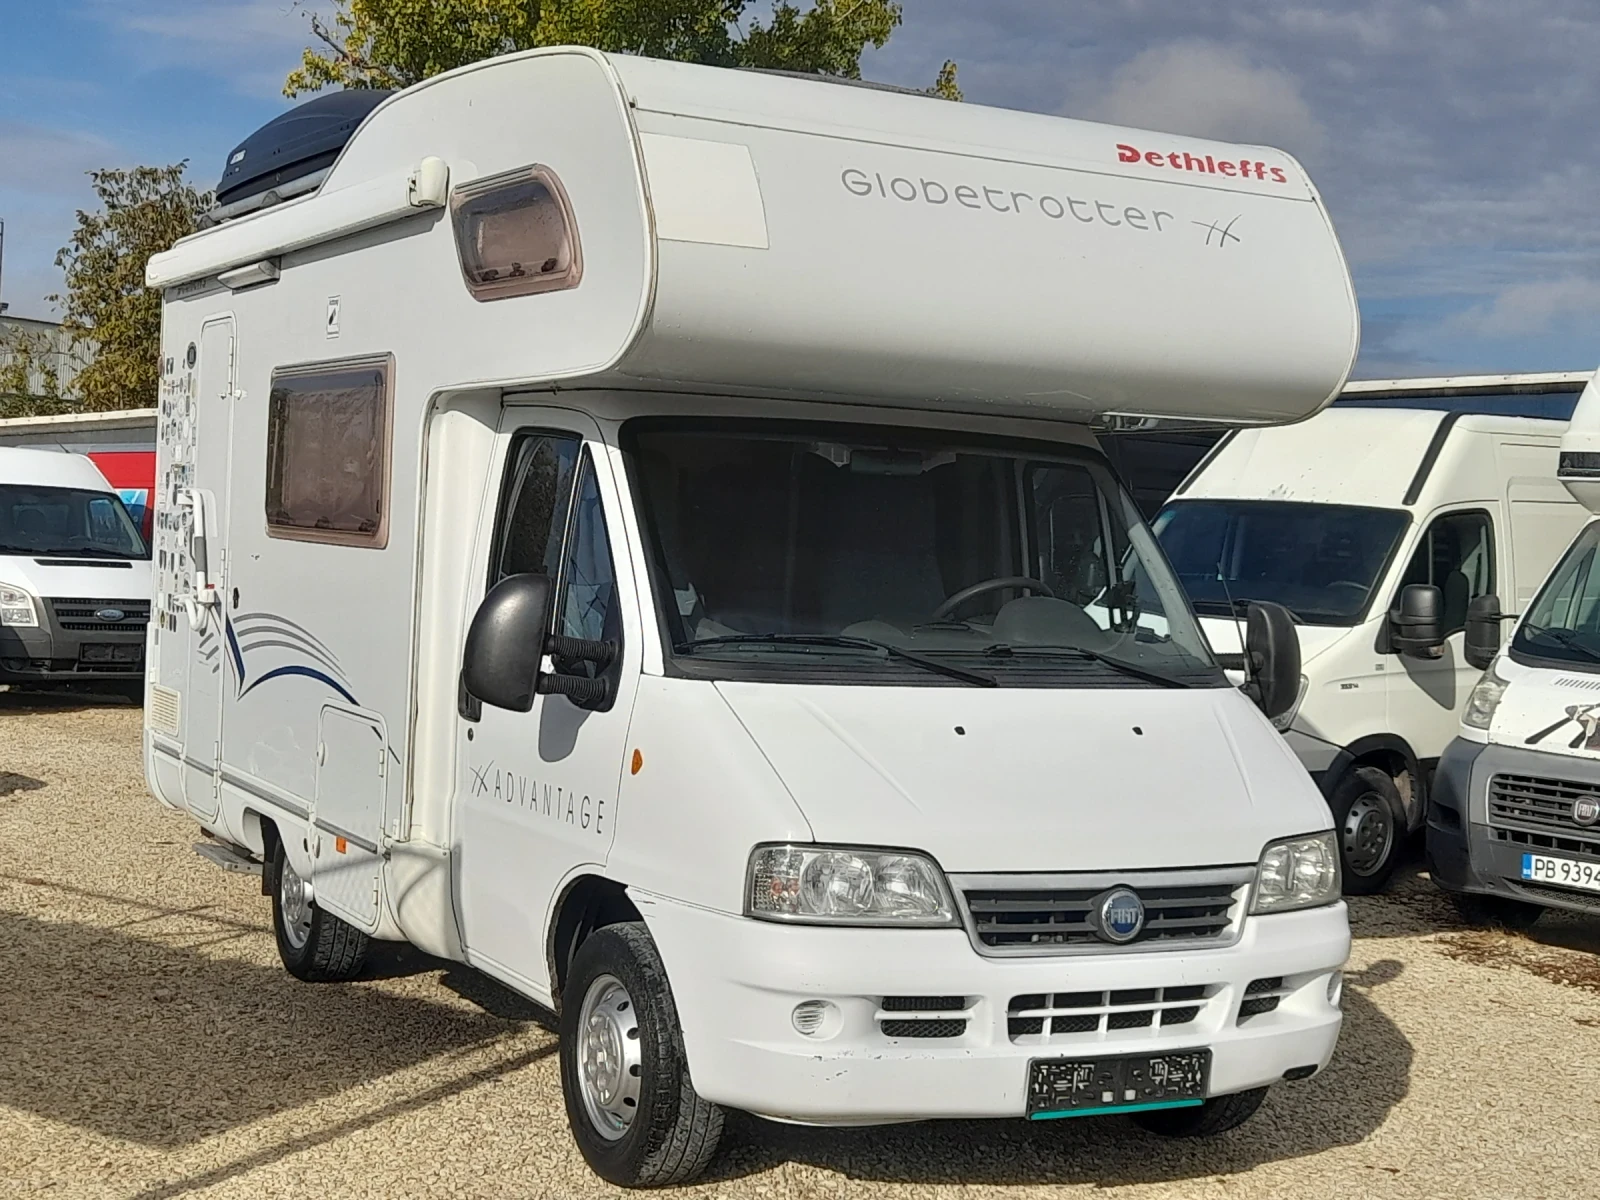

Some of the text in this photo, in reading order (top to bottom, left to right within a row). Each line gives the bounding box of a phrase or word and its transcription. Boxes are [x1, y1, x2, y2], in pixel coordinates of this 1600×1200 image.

[1116, 144, 1287, 183] Dethleffs
[841, 168, 1174, 232] Globetrotter
[494, 769, 605, 834] ADVANTAGE
[1534, 858, 1556, 879] PB
[1110, 908, 1138, 924] FIAT
